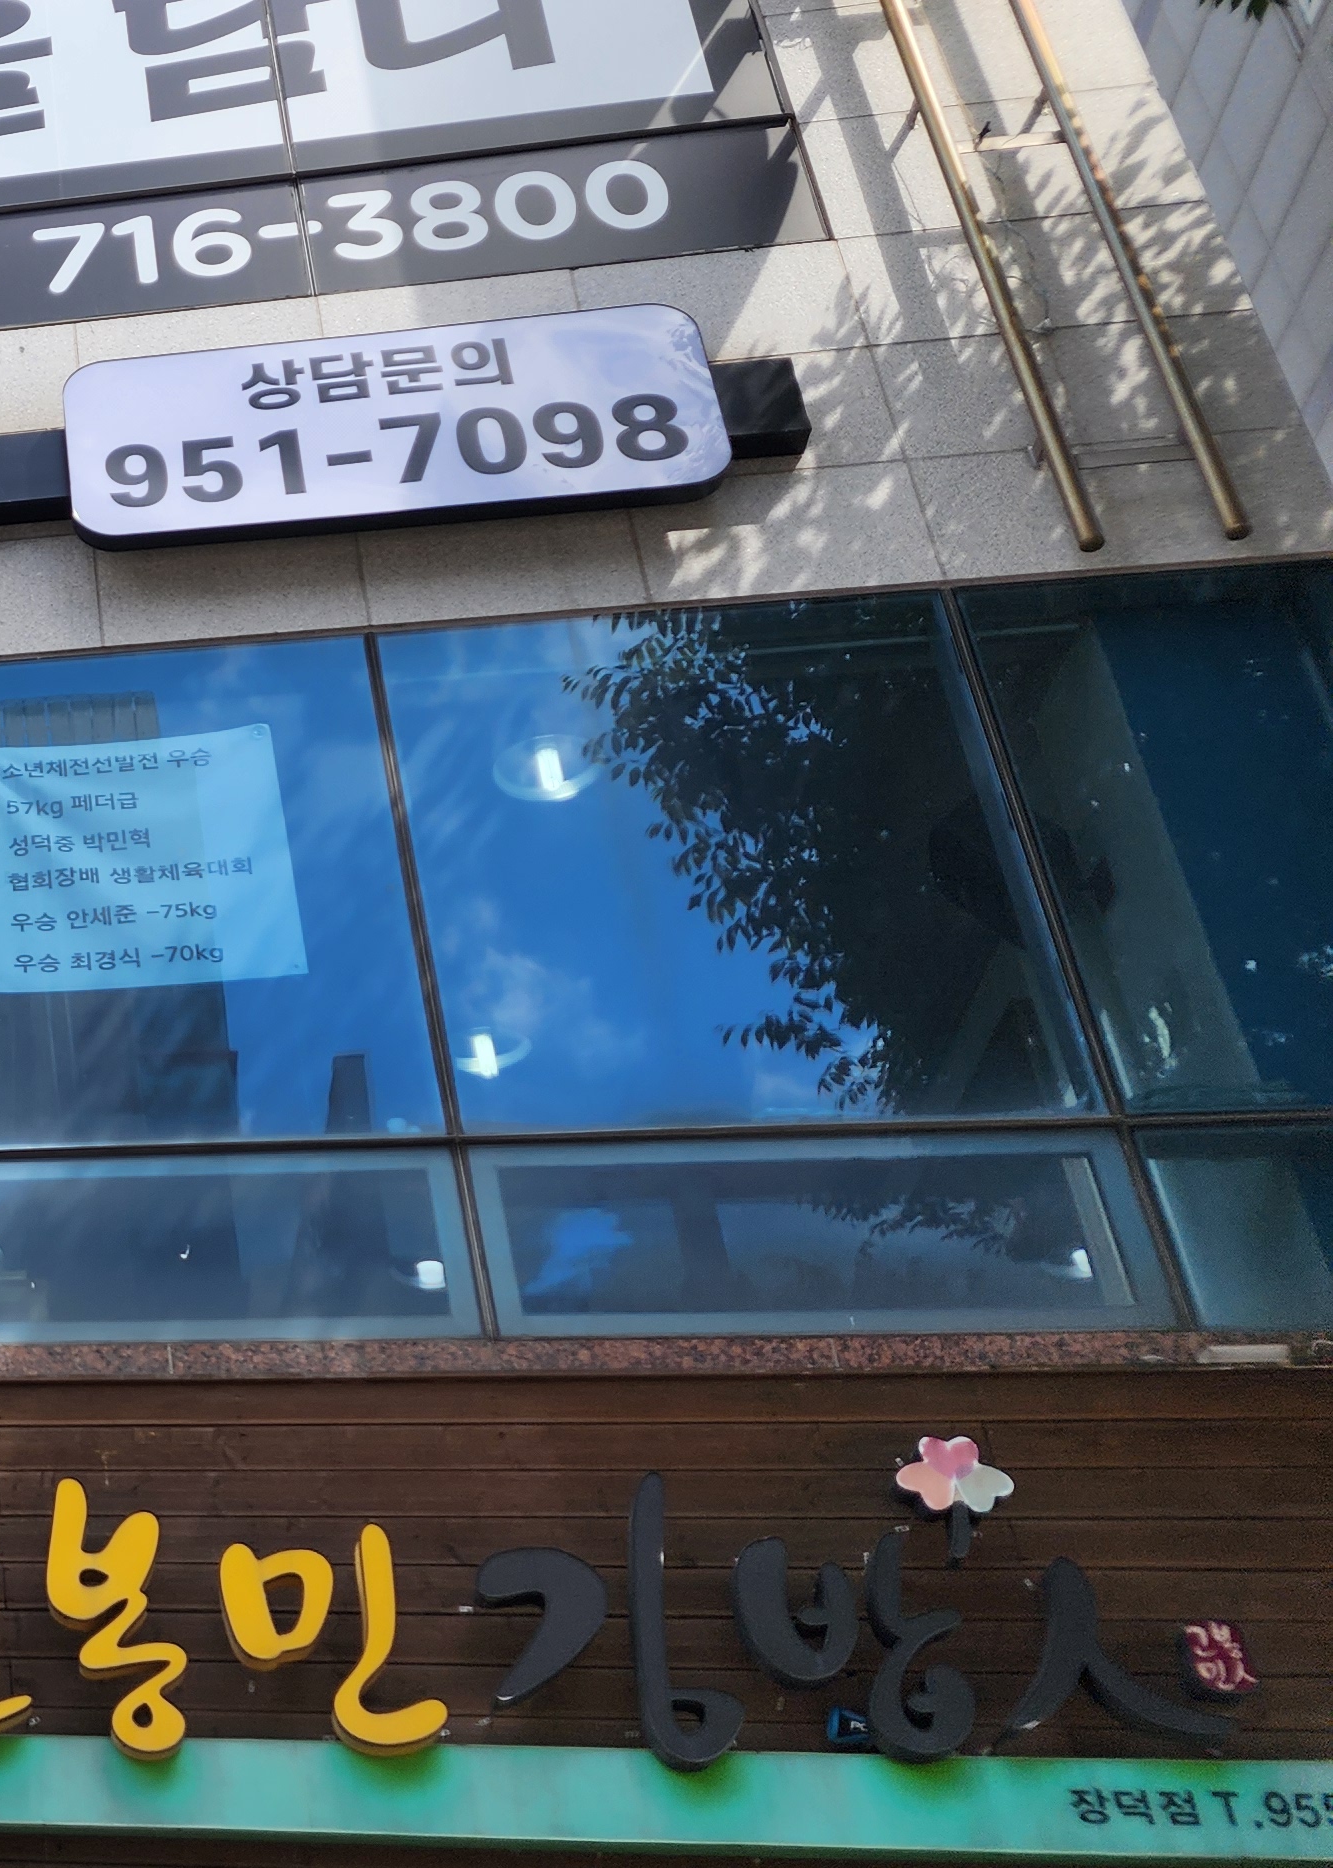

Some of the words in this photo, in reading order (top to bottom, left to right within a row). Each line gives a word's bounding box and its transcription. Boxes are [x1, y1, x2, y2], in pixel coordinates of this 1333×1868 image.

[33, 161, 669, 292] 716-3800
[241, 338, 516, 410] 상담문의
[104, 394, 690, 507] 951-7098
[1, 752, 160, 780] 소년체전선발전
[166, 747, 213, 768] 우승
[5, 800, 64, 819] 57kg
[70, 791, 139, 812] 페더급
[8, 834, 76, 857] 성덕중
[7, 865, 100, 892] 협회장배
[110, 856, 253, 885] 생활체육대회
[10, 912, 57, 932] 우승
[66, 904, 138, 930] 안세준
[13, 953, 61, 973] 우승
[70, 947, 141, 971] 최경식
[1068, 1787, 1201, 1827] 장덕점
